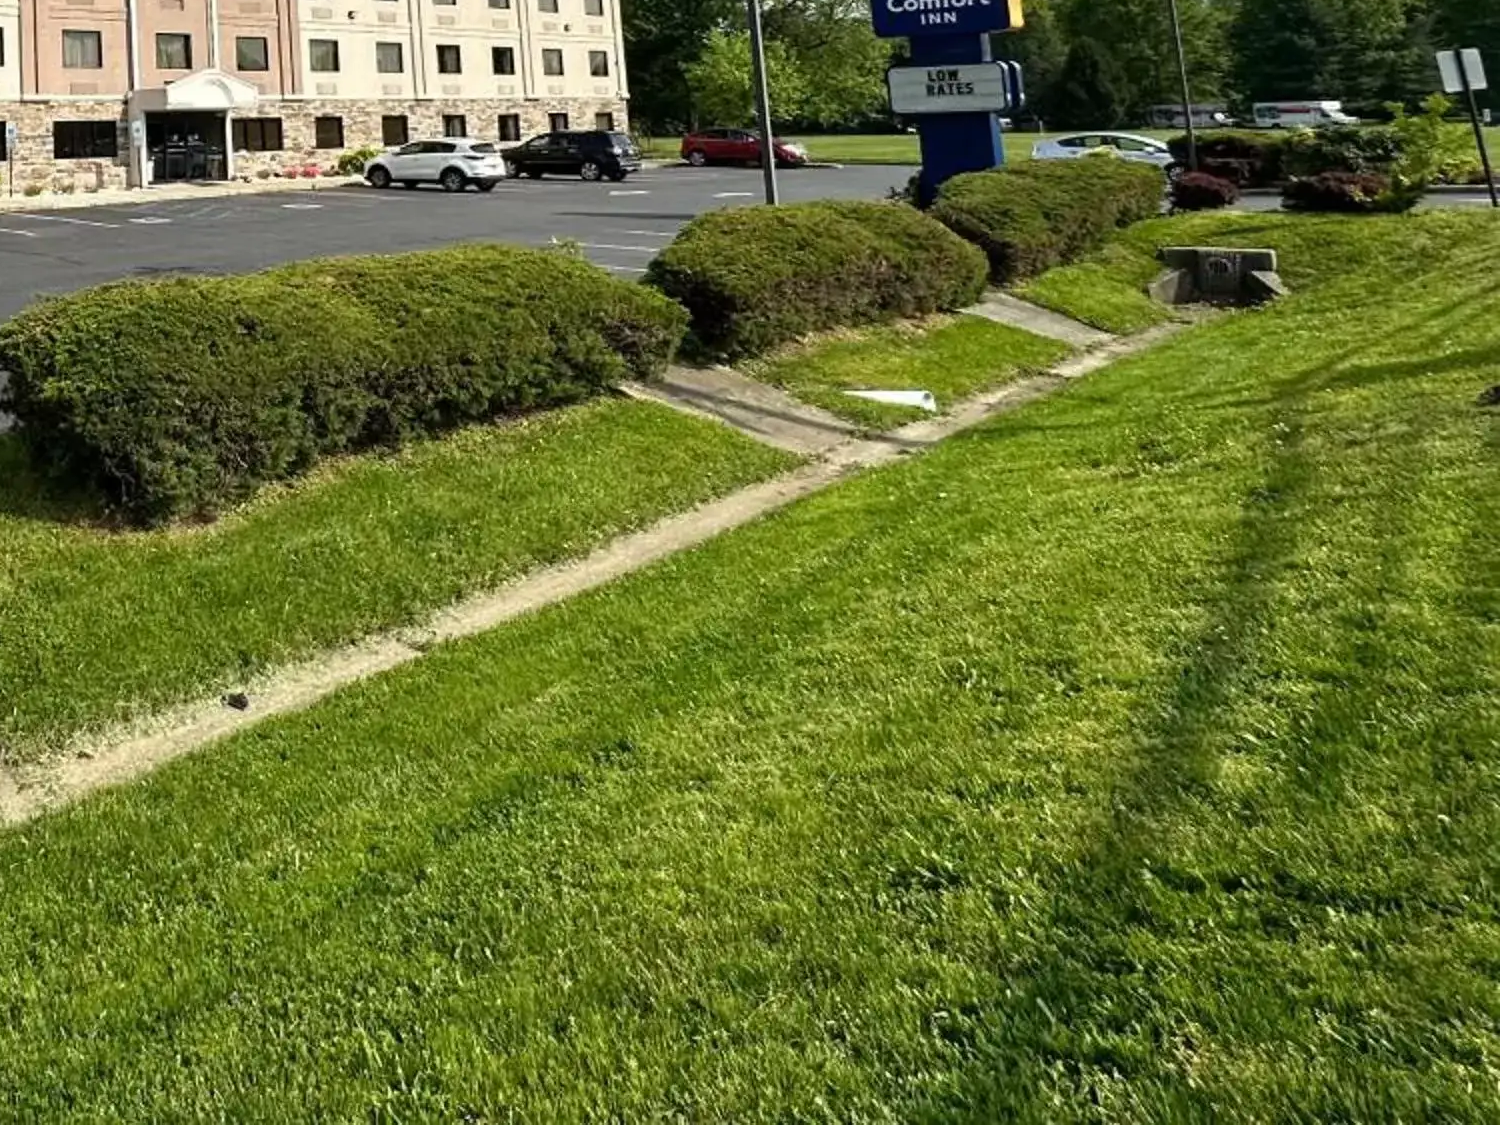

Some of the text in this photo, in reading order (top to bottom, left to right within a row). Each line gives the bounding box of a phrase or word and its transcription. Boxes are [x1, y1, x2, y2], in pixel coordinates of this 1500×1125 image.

[920, 12, 956, 25] INN
[927, 69, 958, 82] LOW
[926, 82, 974, 96] RATES
